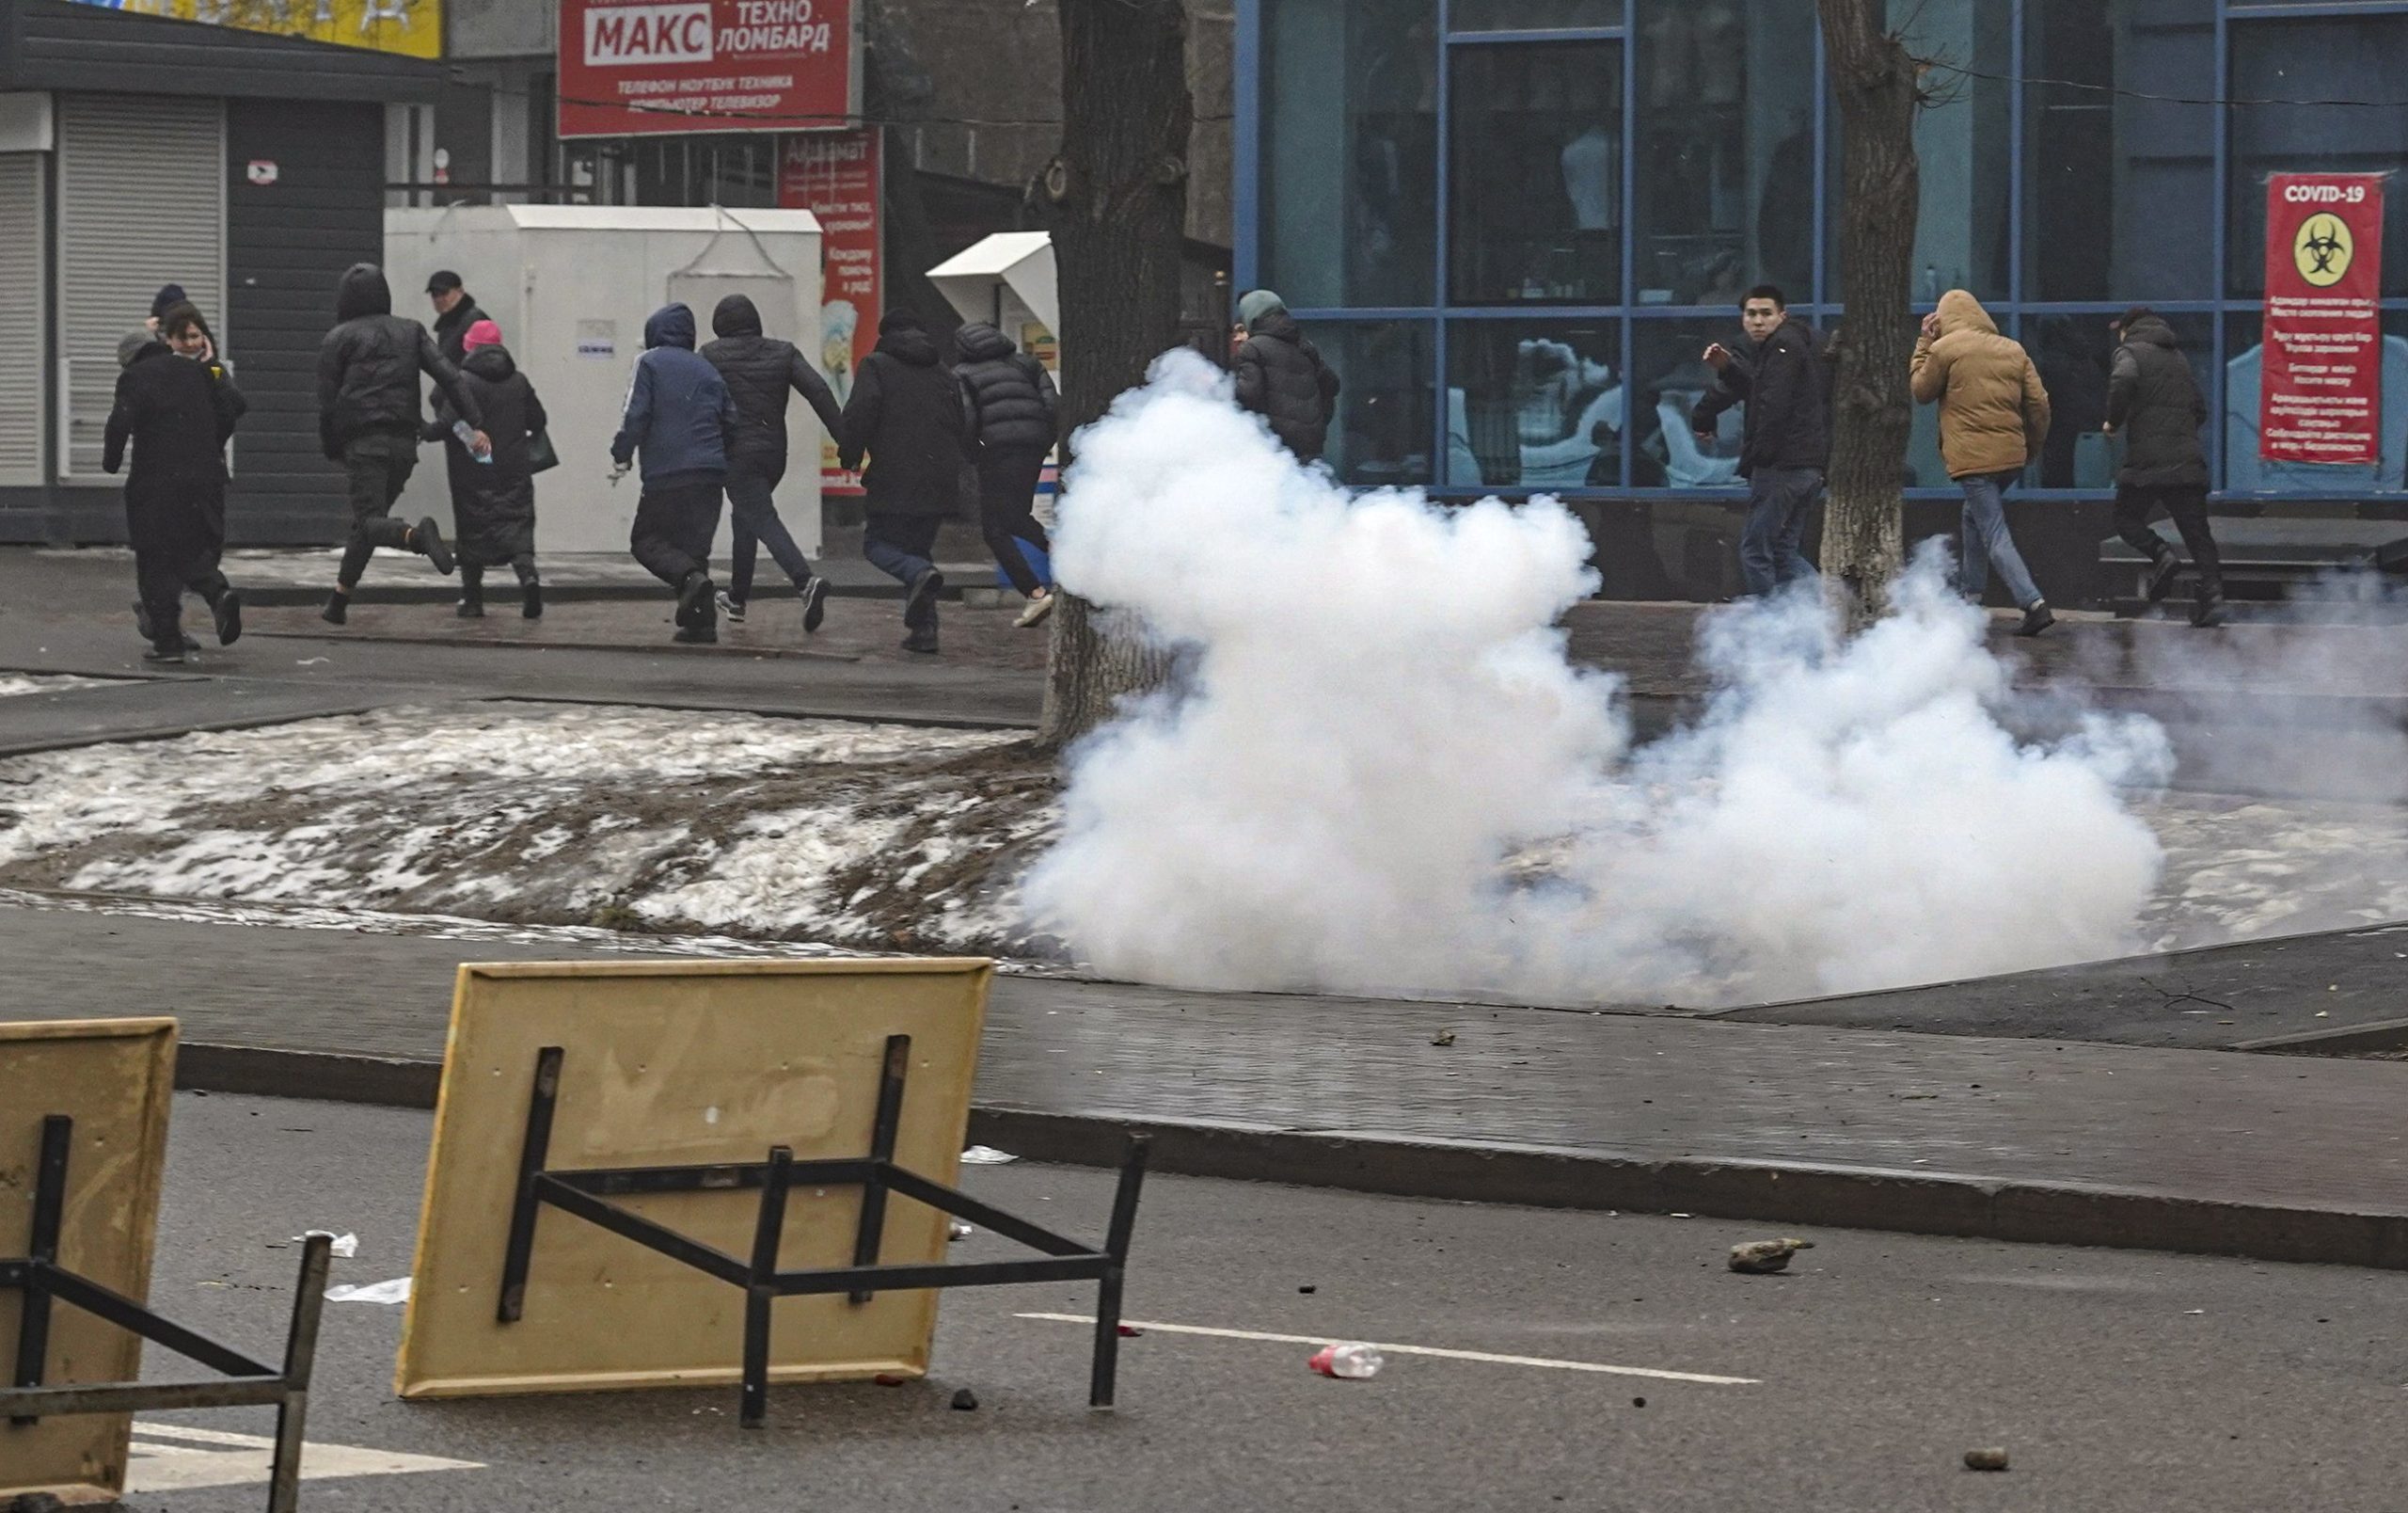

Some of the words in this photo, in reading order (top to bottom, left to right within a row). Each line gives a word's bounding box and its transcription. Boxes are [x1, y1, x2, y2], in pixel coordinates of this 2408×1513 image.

[737, 2, 812, 24] ТЕХНО
[593, 13, 706, 56] МАКС
[716, 24, 830, 52] ЛОМБАРД
[738, 75, 793, 89] ТЕХНИКА
[2285, 184, 2366, 203] COVID-19
